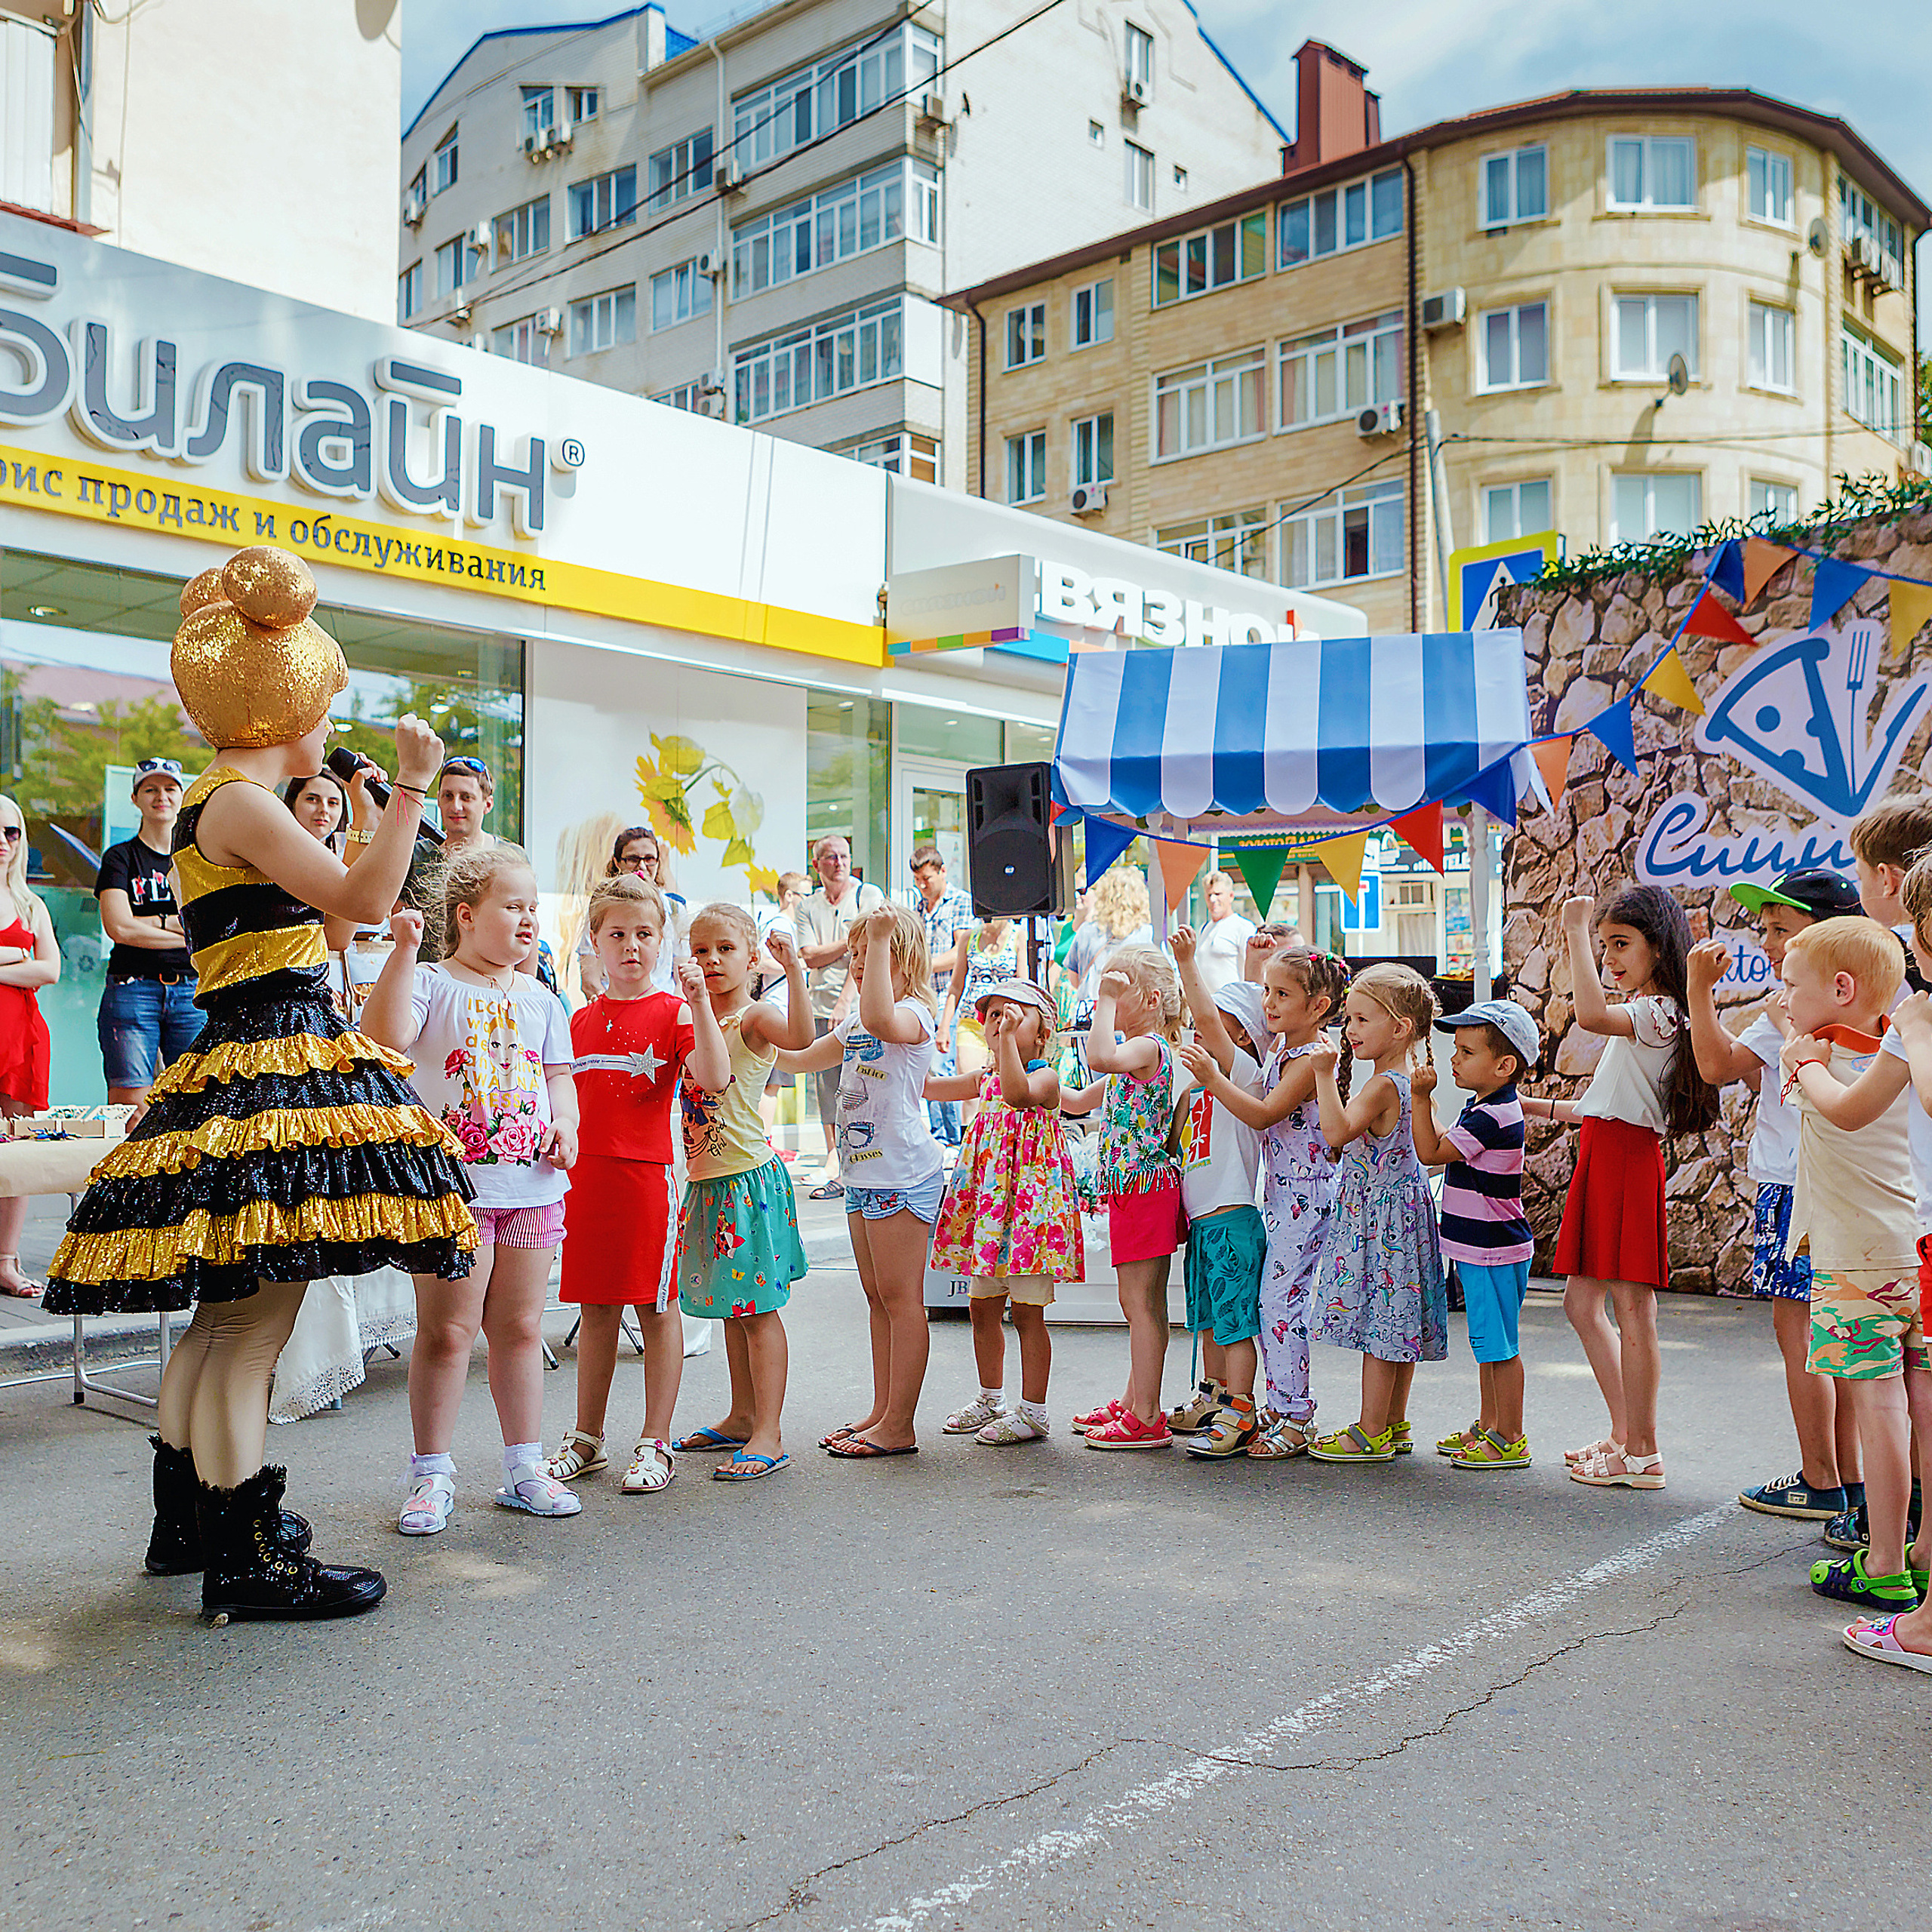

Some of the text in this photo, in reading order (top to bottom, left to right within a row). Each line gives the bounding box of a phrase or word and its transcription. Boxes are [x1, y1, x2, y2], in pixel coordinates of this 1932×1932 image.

[0, 458, 546, 591] ис продаж и обслуживания
[1645, 802, 1856, 878] Сици
[947, 1280, 971, 1298] JB
